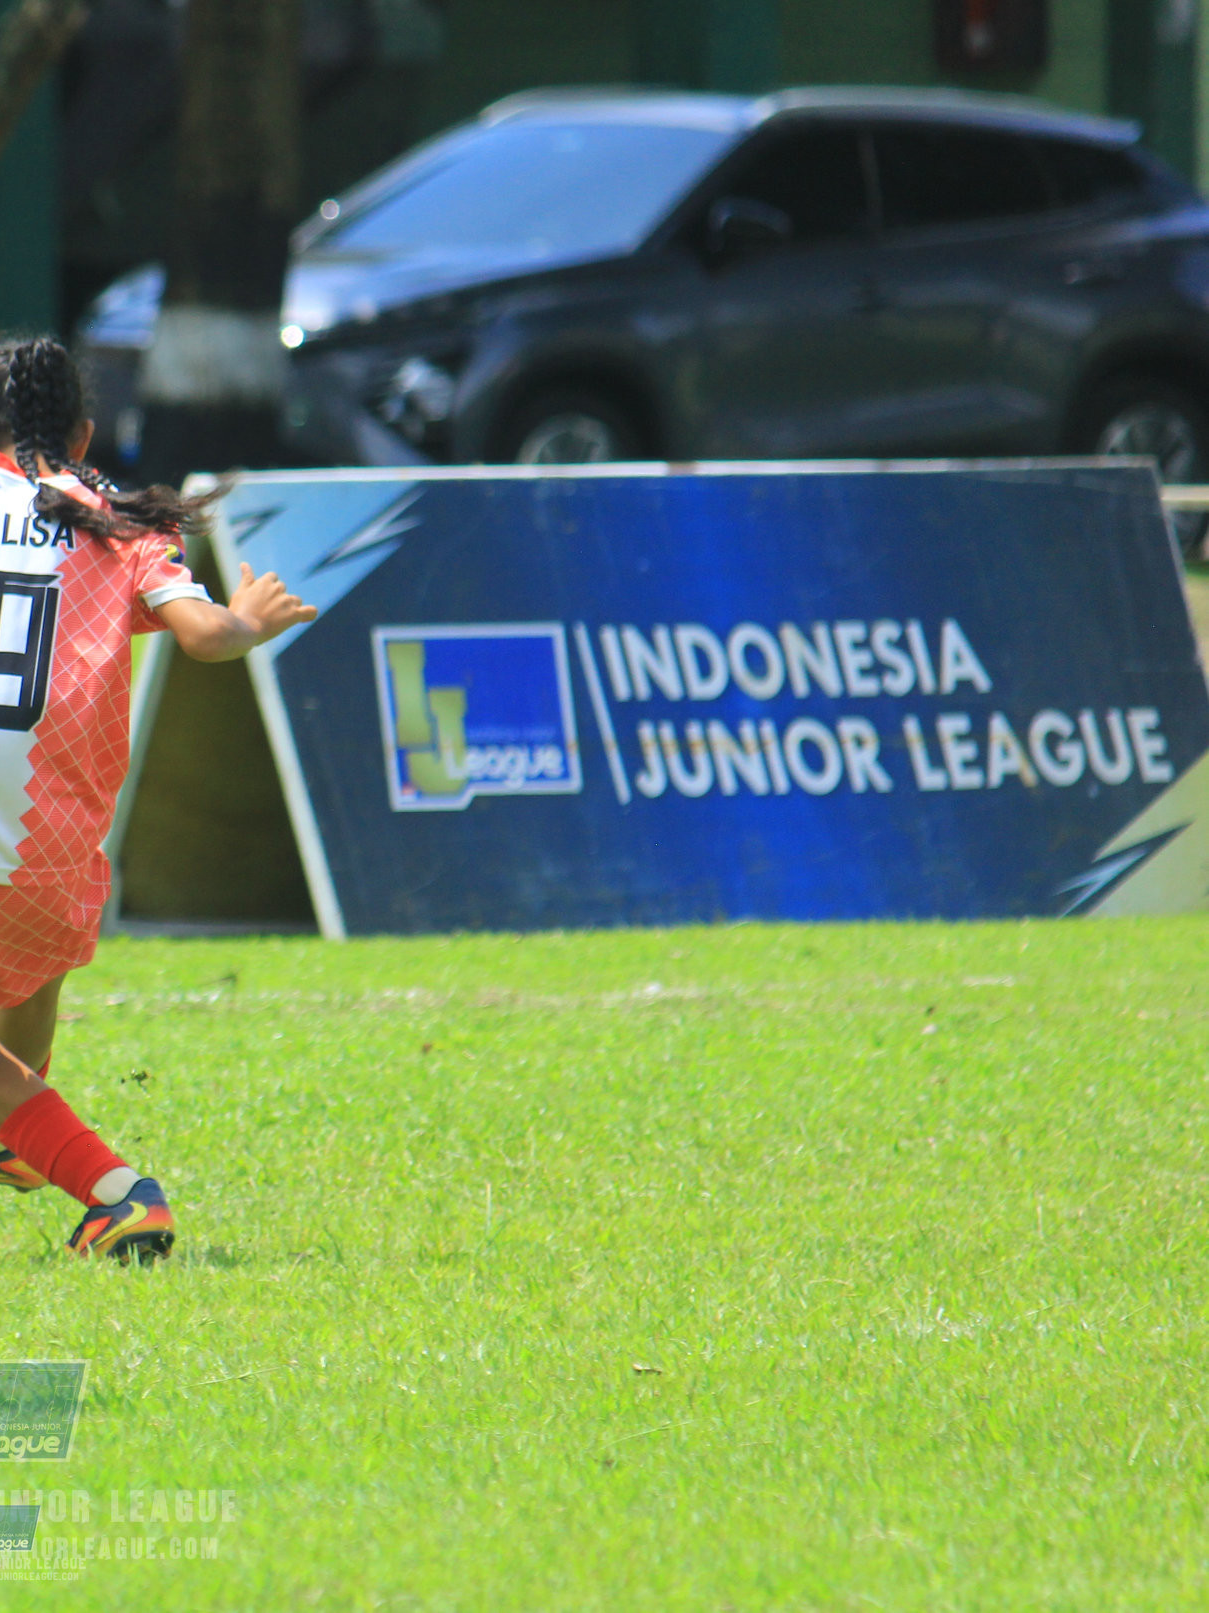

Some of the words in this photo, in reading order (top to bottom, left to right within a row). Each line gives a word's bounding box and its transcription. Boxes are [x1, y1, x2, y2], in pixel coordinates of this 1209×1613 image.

[600, 618, 991, 702] INDONESIA
[442, 734, 565, 788] League
[634, 715, 892, 799] JUNIOR
[904, 707, 1174, 793] LEAGUE
